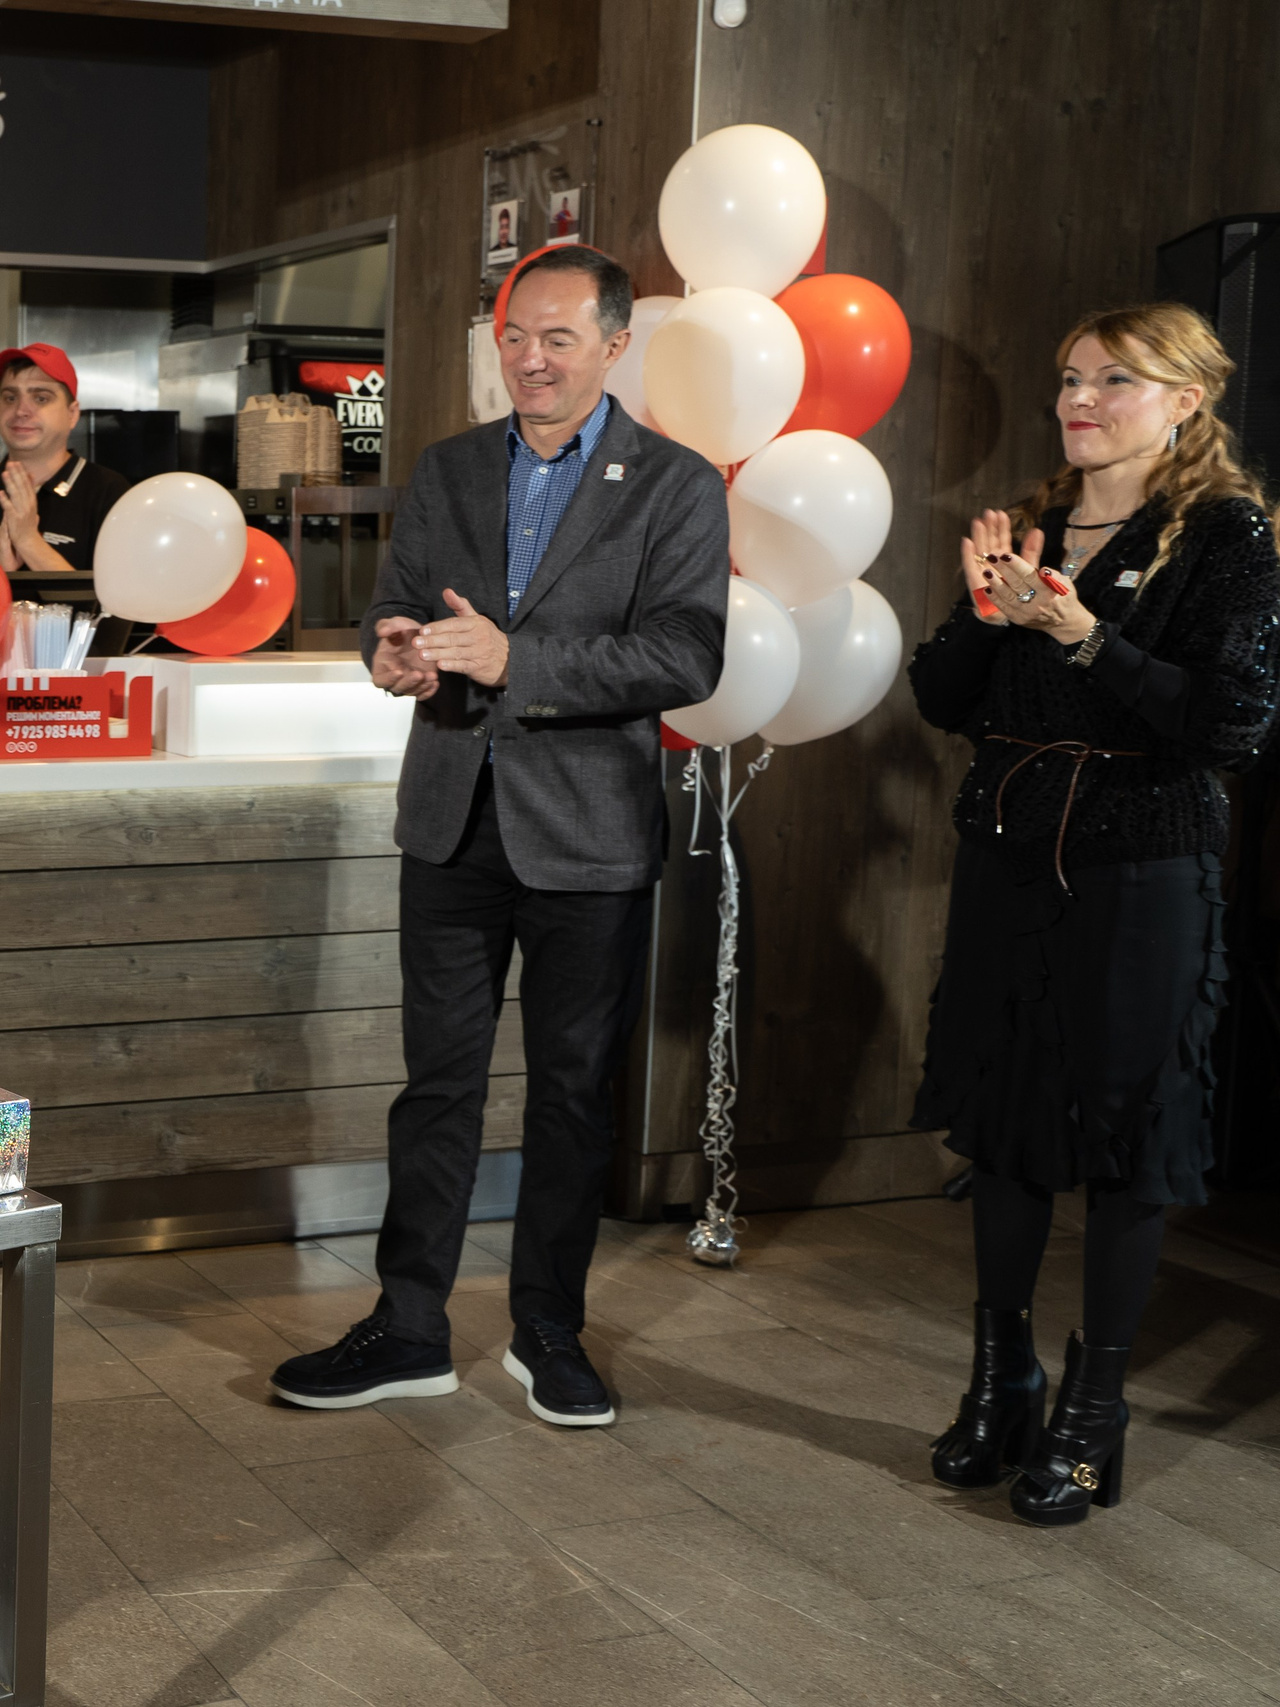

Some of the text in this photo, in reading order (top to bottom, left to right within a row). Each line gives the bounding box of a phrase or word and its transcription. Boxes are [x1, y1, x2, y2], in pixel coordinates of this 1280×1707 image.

[7, 695, 83, 711] ПРОБЛЕМА?
[5, 724, 100, 739] +7 925 985 44 98
